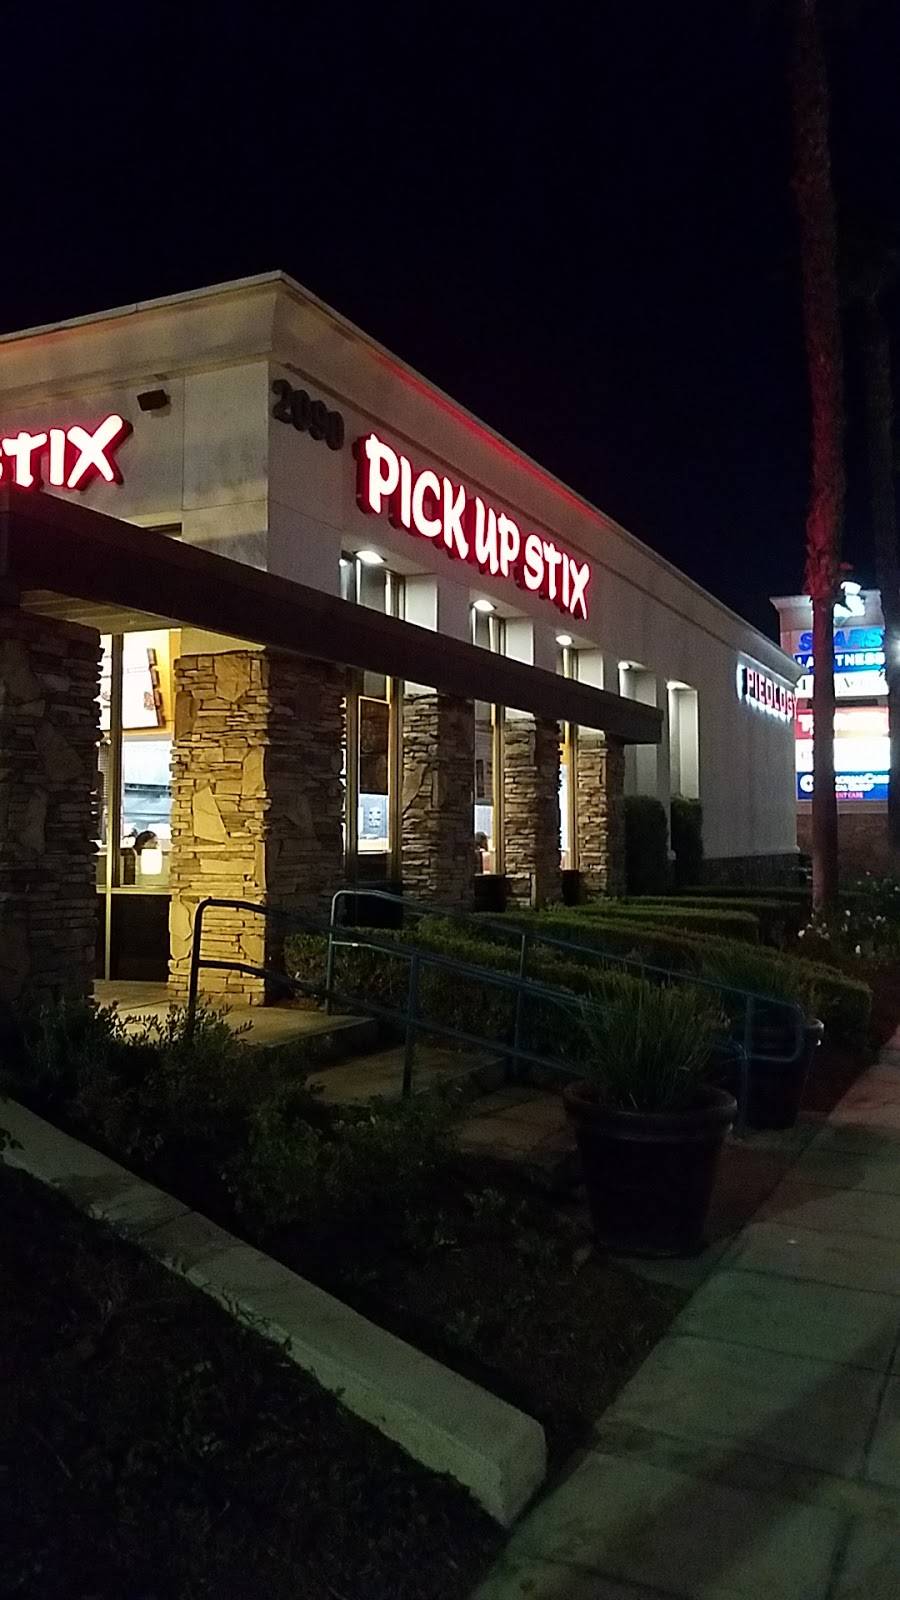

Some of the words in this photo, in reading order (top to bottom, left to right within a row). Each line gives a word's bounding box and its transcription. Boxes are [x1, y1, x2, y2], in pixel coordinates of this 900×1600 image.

[0, 414, 125, 488] TIX
[362, 433, 469, 560] PICK
[474, 496, 521, 578] UP
[523, 533, 591, 621] STIX
[800, 629, 883, 650] SARS
[745, 666, 798, 721] PIEOLOGY
